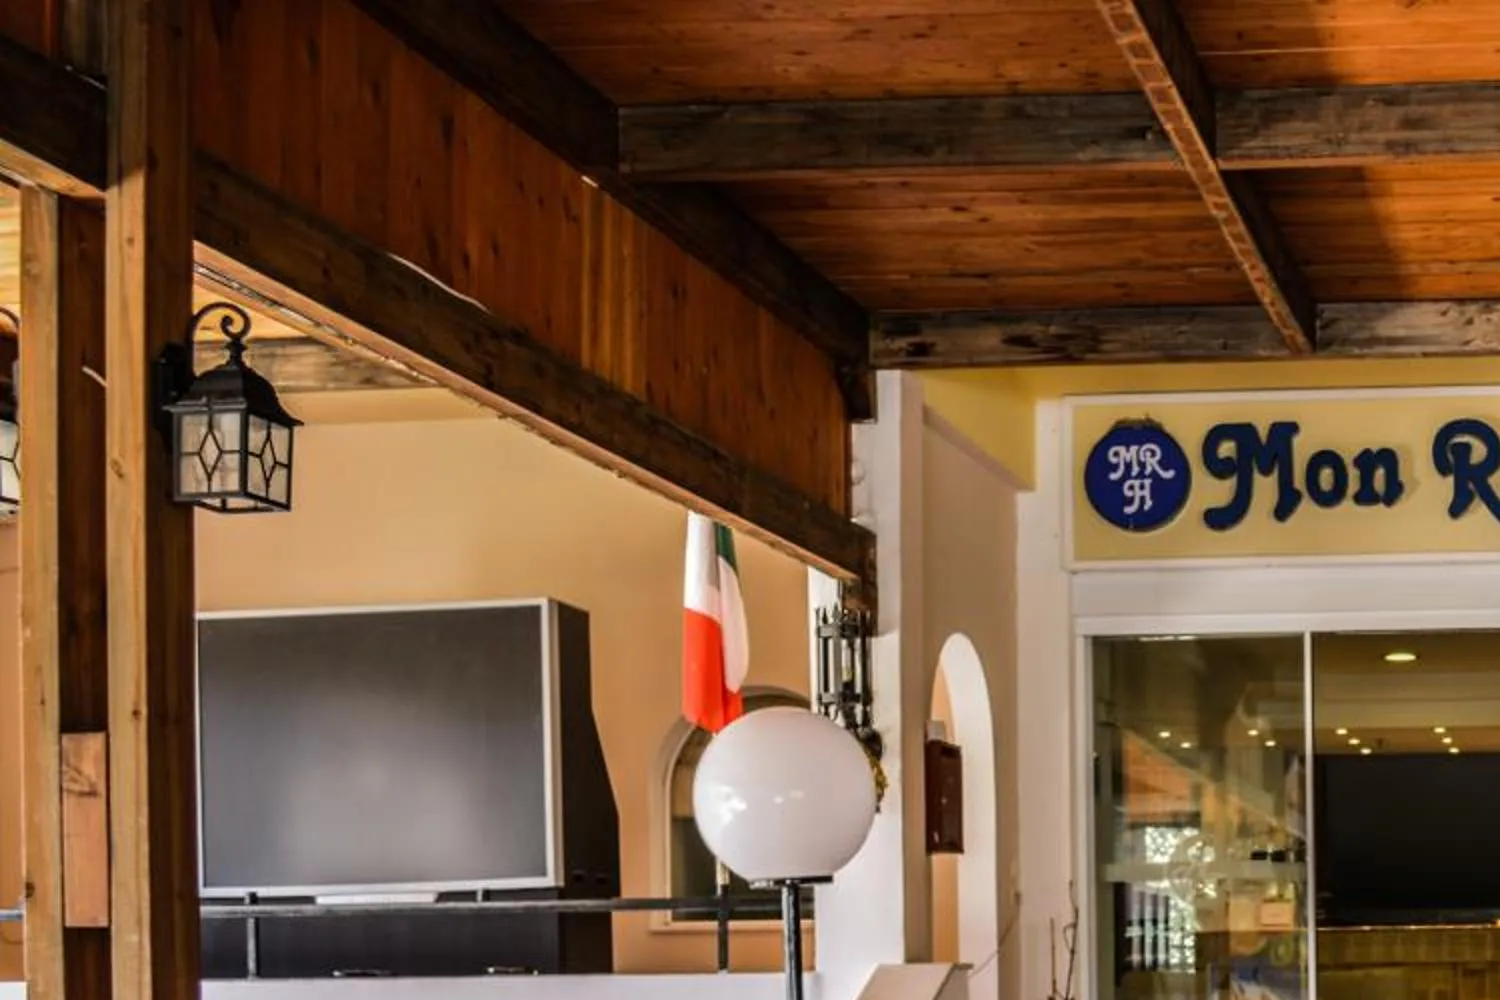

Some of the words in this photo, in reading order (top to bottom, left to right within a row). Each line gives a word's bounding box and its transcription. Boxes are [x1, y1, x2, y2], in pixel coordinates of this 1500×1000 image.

[1108, 443, 1175, 480] MR
[1201, 421, 1405, 532] Mon
[1123, 478, 1153, 515] H
